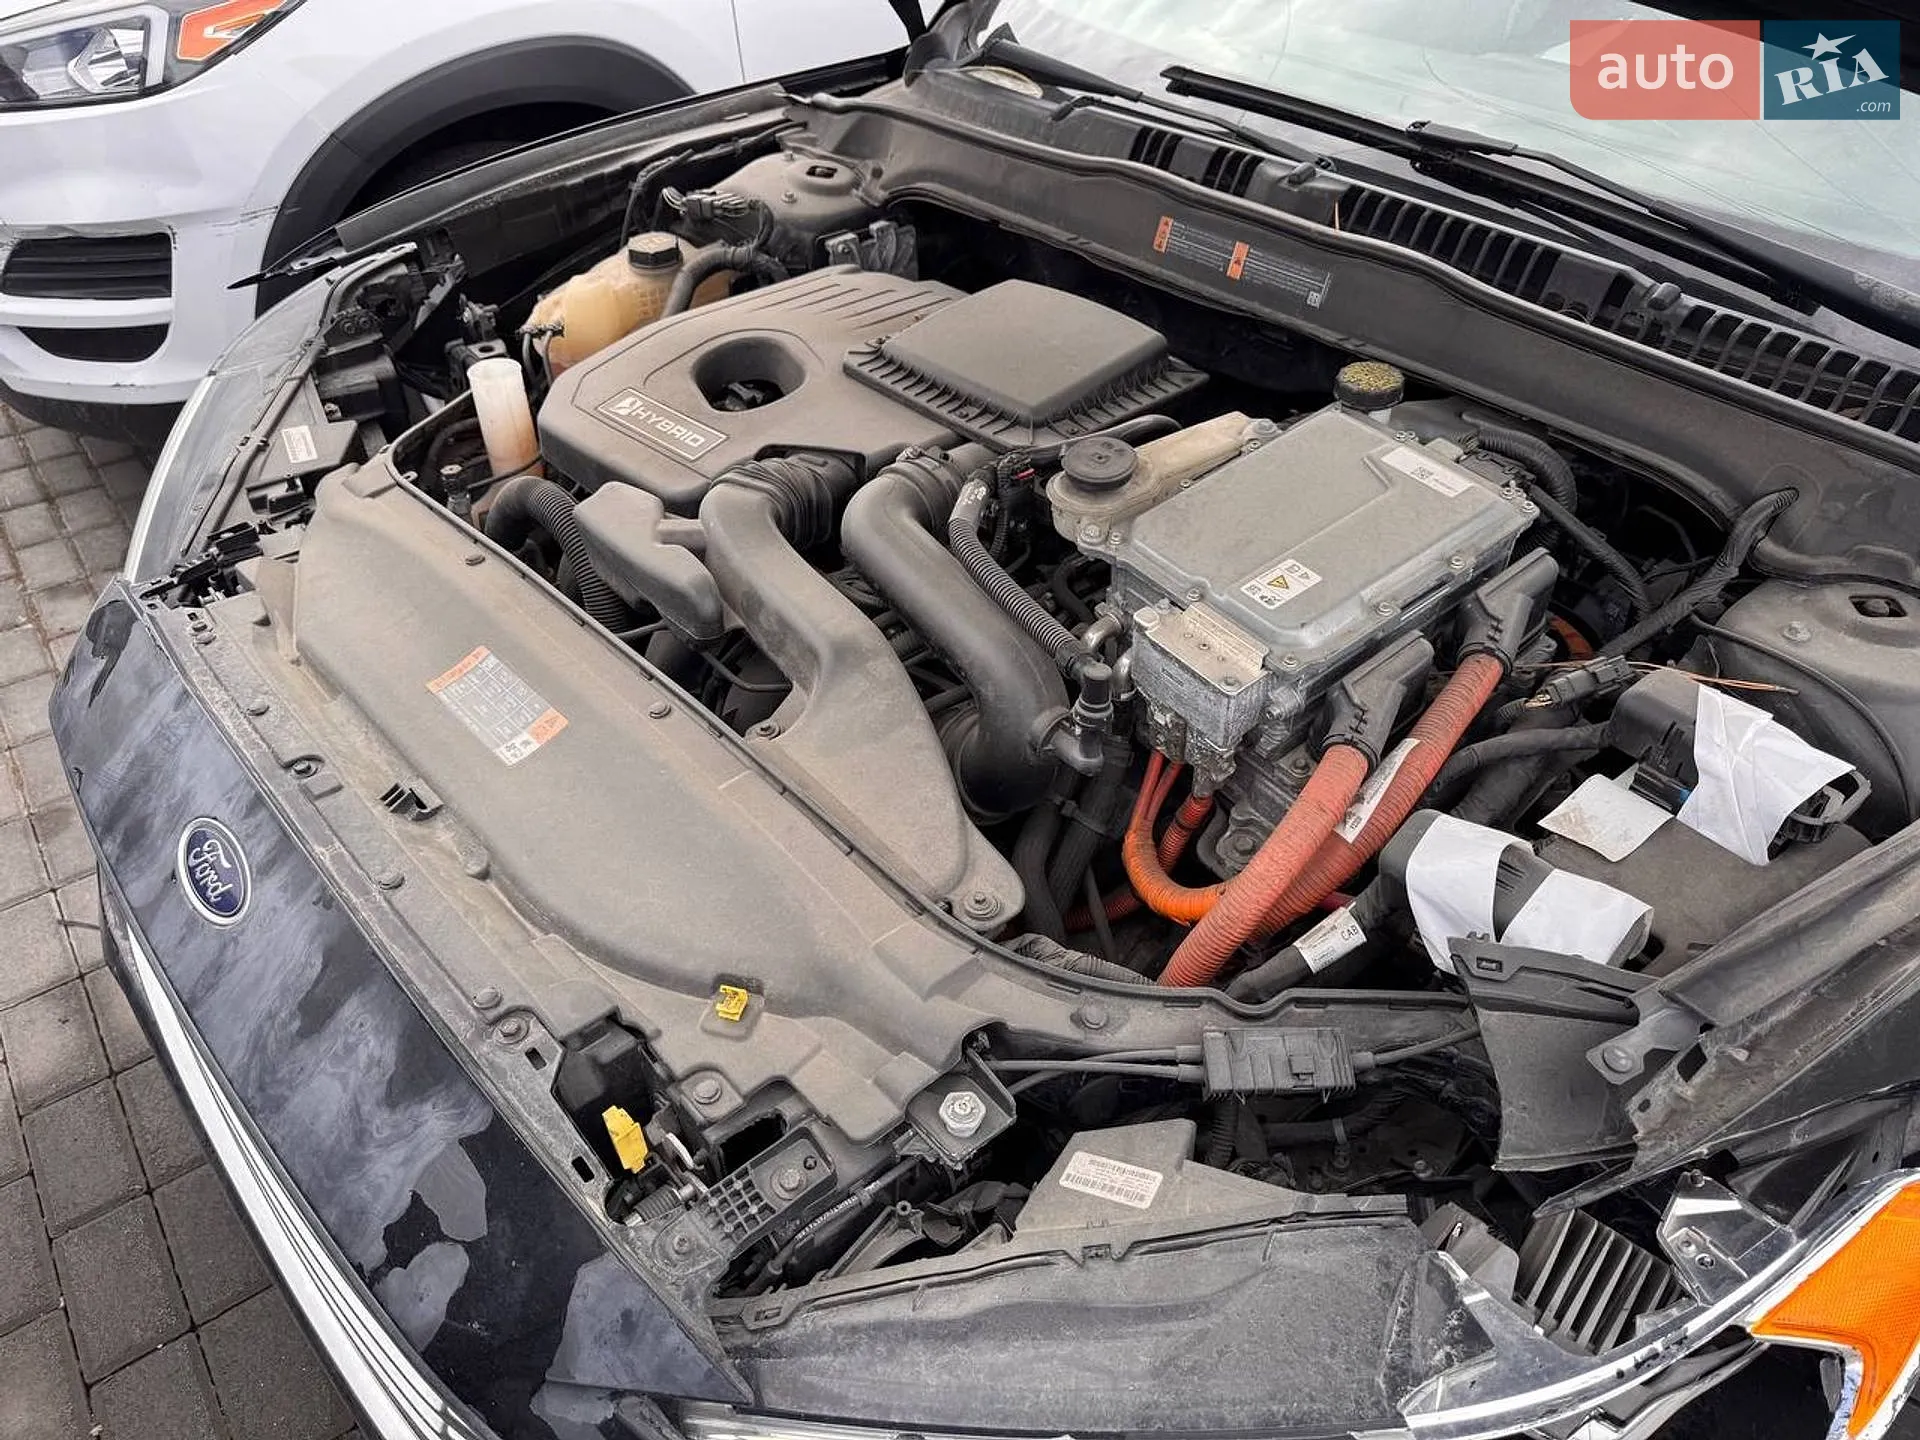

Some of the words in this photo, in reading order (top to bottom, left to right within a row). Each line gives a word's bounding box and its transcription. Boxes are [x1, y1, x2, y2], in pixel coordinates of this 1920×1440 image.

[630, 403, 705, 448] HYBRID
[188, 838, 233, 903] Ford
[1340, 924, 1360, 942] CAB
